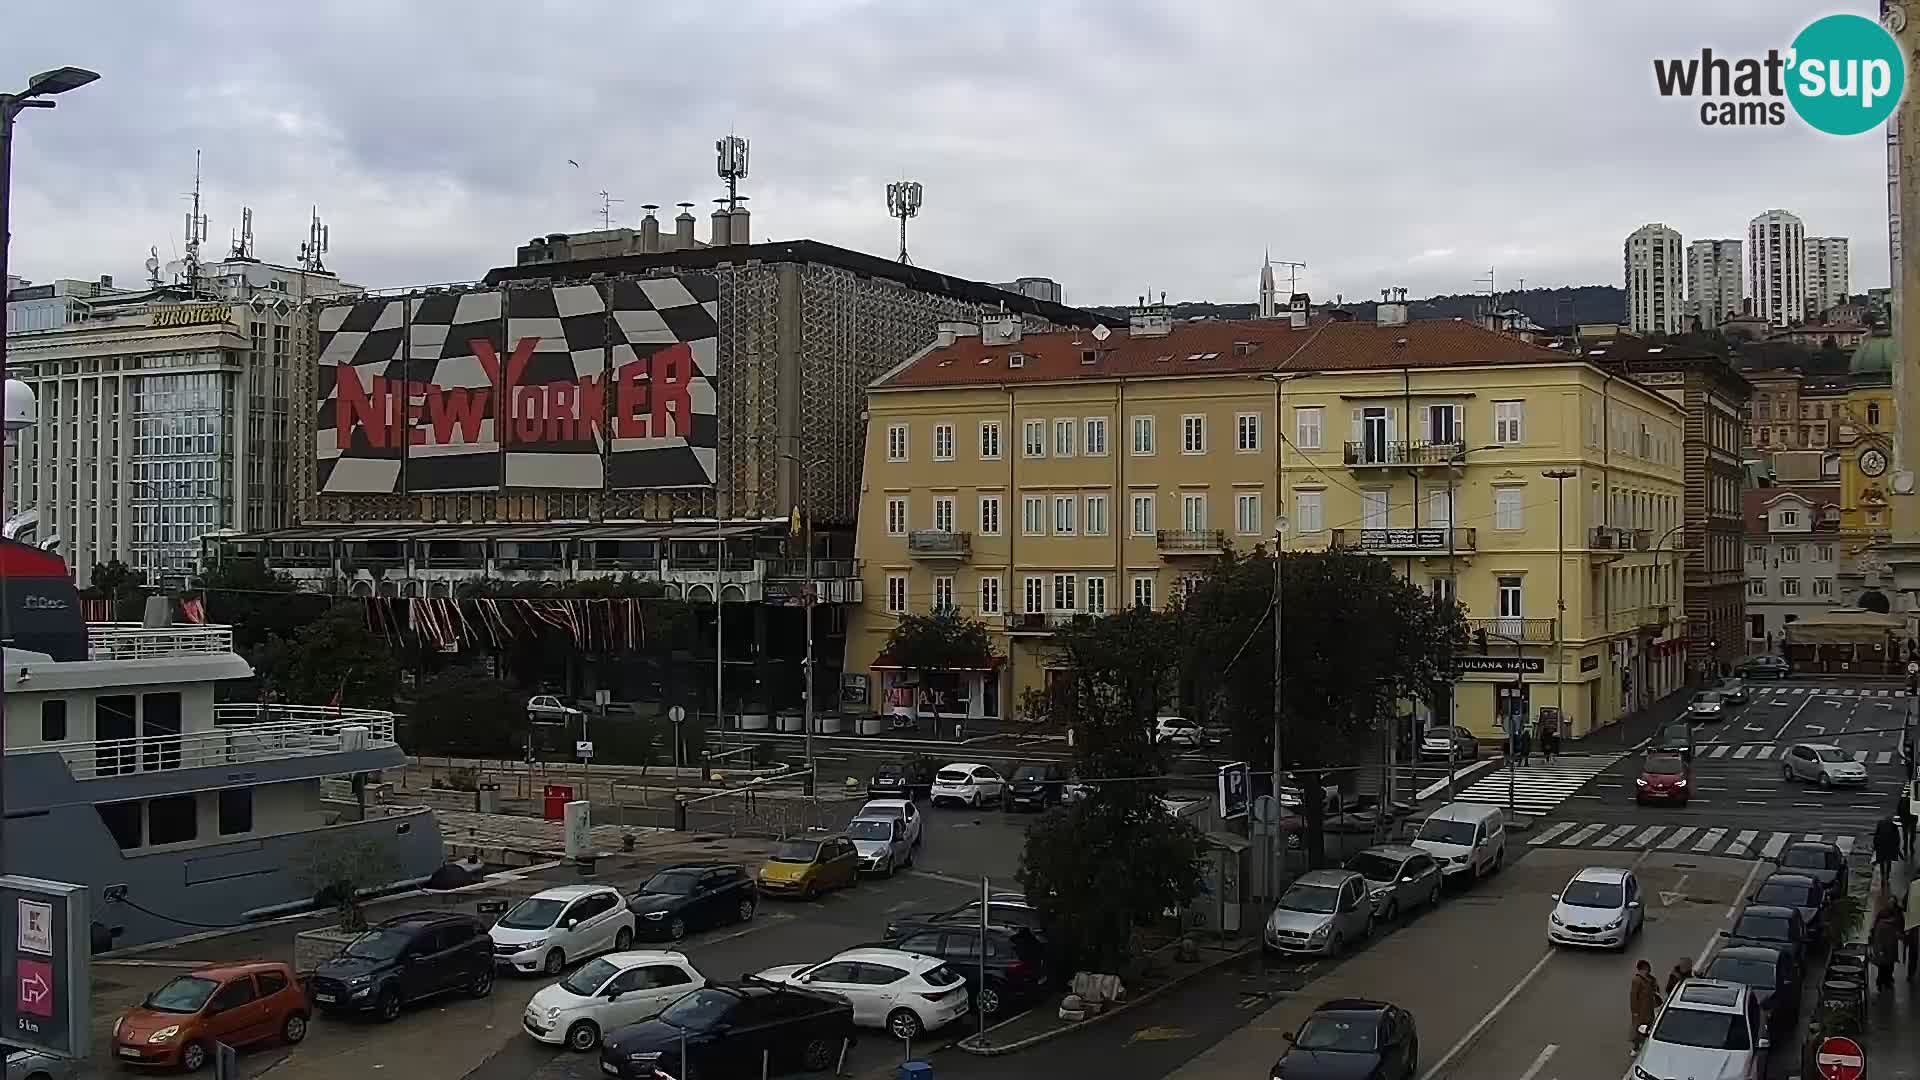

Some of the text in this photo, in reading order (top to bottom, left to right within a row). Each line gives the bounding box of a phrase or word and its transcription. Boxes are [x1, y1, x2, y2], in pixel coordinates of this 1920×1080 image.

[337, 336, 692, 449] NEW YORKER
[1457, 661, 1538, 670] JULIANA NAILS
[19, 1018, 39, 1033] 5 km
